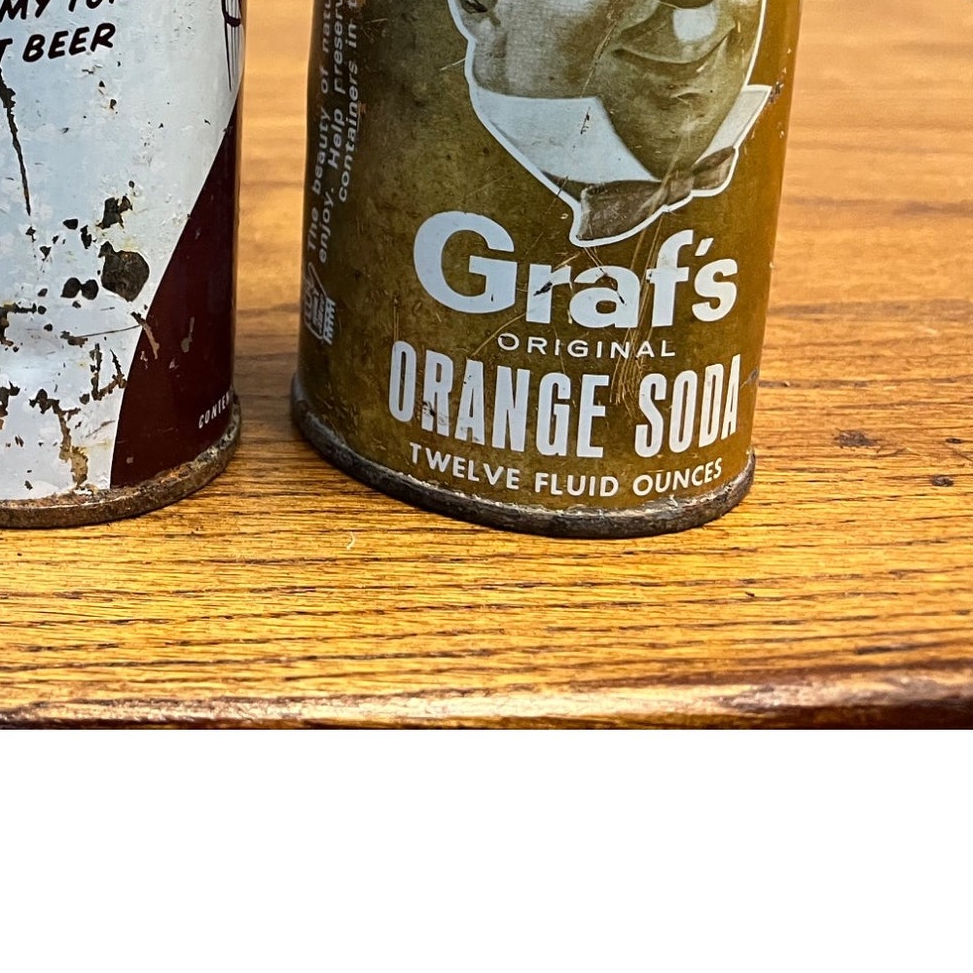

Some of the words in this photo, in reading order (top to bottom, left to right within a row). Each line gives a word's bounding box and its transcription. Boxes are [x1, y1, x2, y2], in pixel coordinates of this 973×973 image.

[22, 22, 116, 63] BEER
[345, 19, 358, 49] in
[319, 64, 329, 94] of
[311, 106, 331, 195] beauty
[338, 59, 360, 202] containers
[318, 186, 335, 264] enjoy.
[327, 107, 346, 169] Help
[306, 207, 319, 251] The
[413, 210, 739, 329] Graf's
[497, 333, 676, 359] ORIGINAL
[388, 340, 610, 459] ORANGE
[634, 353, 742, 458] SODA
[409, 442, 521, 491] TWELVE
[534, 472, 620, 498] FLUID
[632, 457, 723, 497] OUNCES
